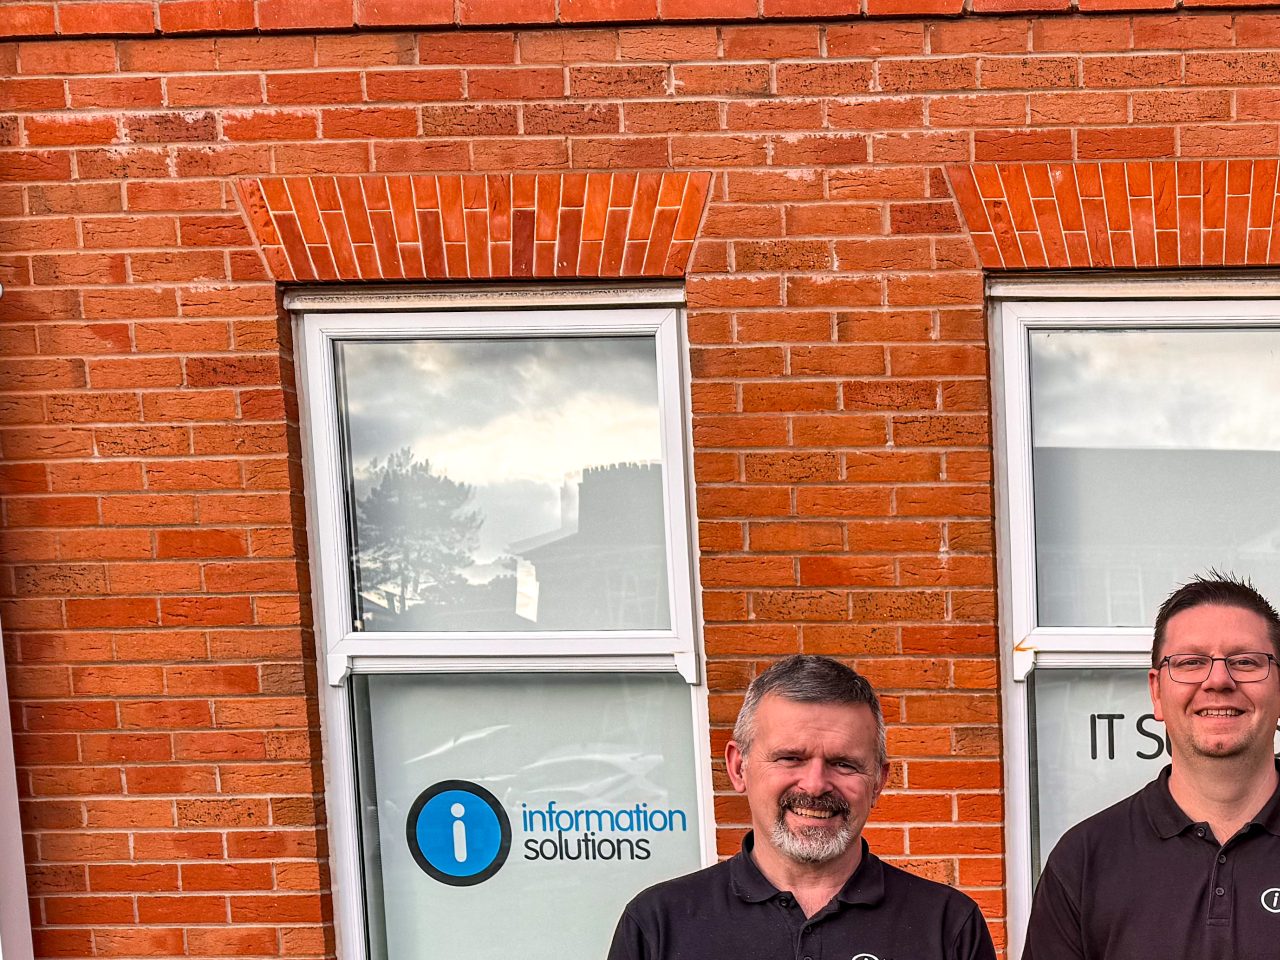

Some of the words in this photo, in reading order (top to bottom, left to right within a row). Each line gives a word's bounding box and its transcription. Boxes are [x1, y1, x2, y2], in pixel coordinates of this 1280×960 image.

[1090, 713, 1125, 760] IT
[521, 801, 688, 832] information
[523, 830, 651, 861] solutions
